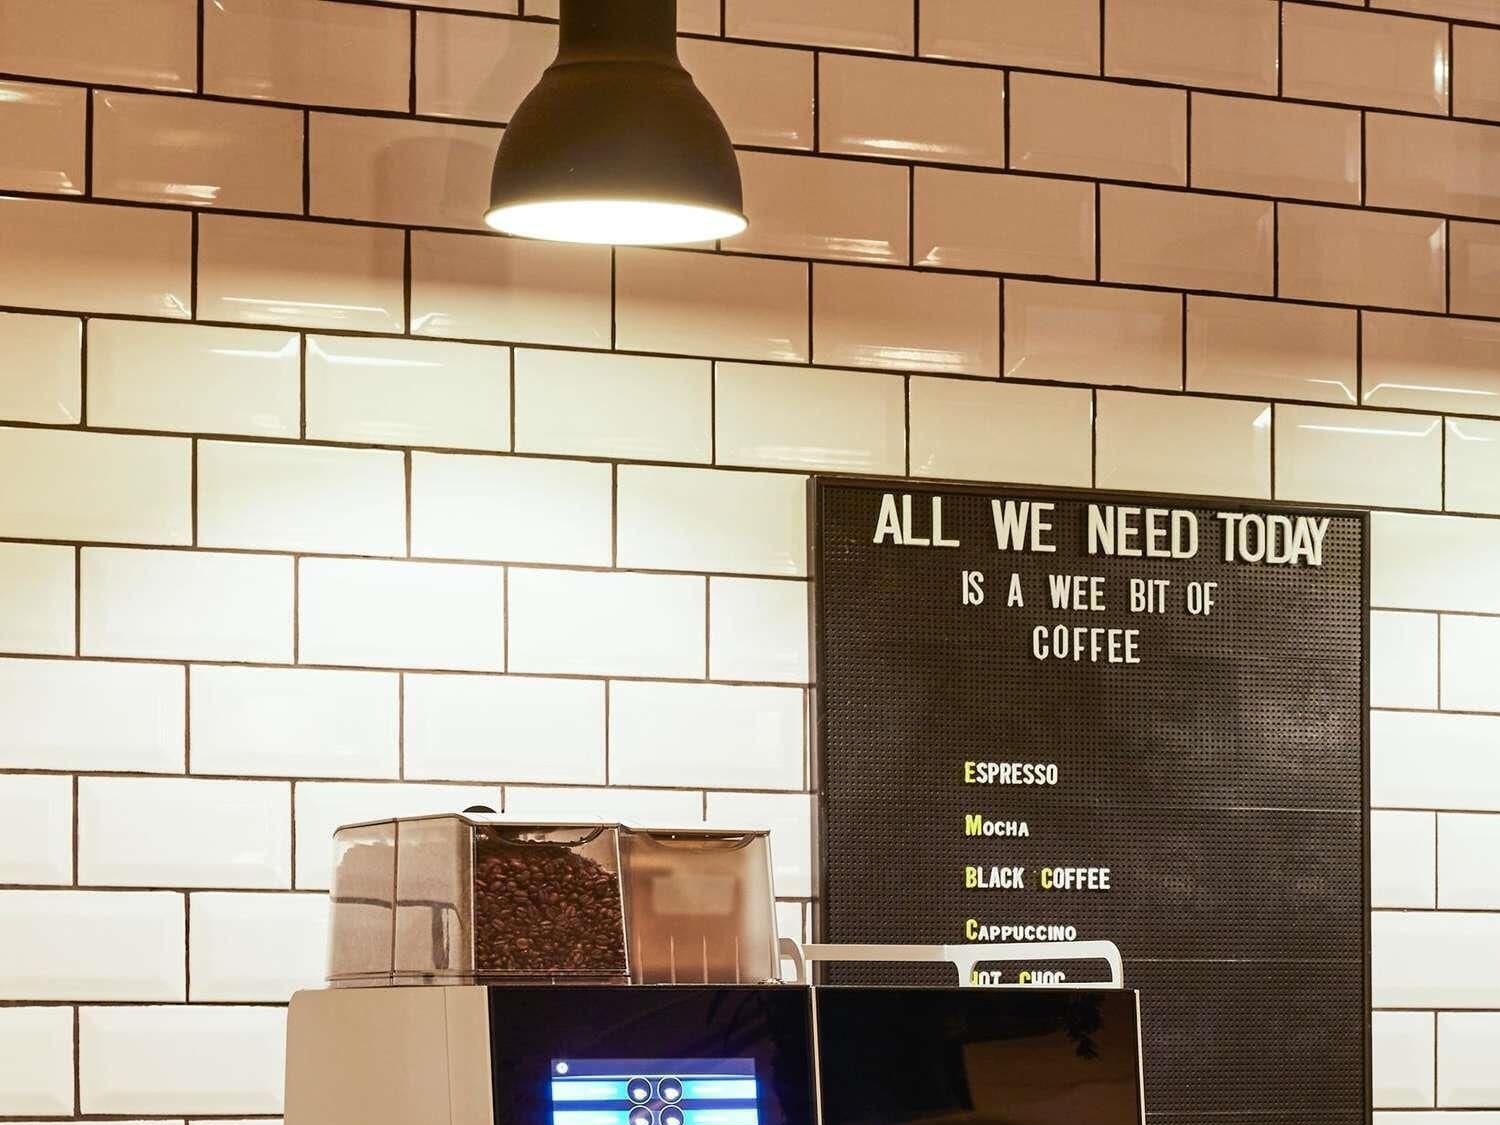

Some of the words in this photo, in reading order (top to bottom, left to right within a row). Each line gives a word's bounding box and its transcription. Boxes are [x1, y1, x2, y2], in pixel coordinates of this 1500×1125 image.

[872, 493, 960, 547] ALL
[991, 499, 1057, 553] WE
[1087, 504, 1200, 560] NEED
[1217, 511, 1331, 566] TODAY
[962, 570, 984, 606] IS
[1007, 573, 1024, 607] A
[1048, 574, 1106, 612] WEE
[1130, 578, 1171, 614] BIT
[1187, 581, 1218, 616] OF
[1033, 624, 1141, 664] COFFEE
[965, 761, 1058, 786] ESPRESSO
[965, 814, 1030, 837] MOCHA
[965, 865, 1025, 890] BLACK
[1040, 867, 1111, 890] COFFEE
[966, 918, 1077, 941] CAPPUCCINO
